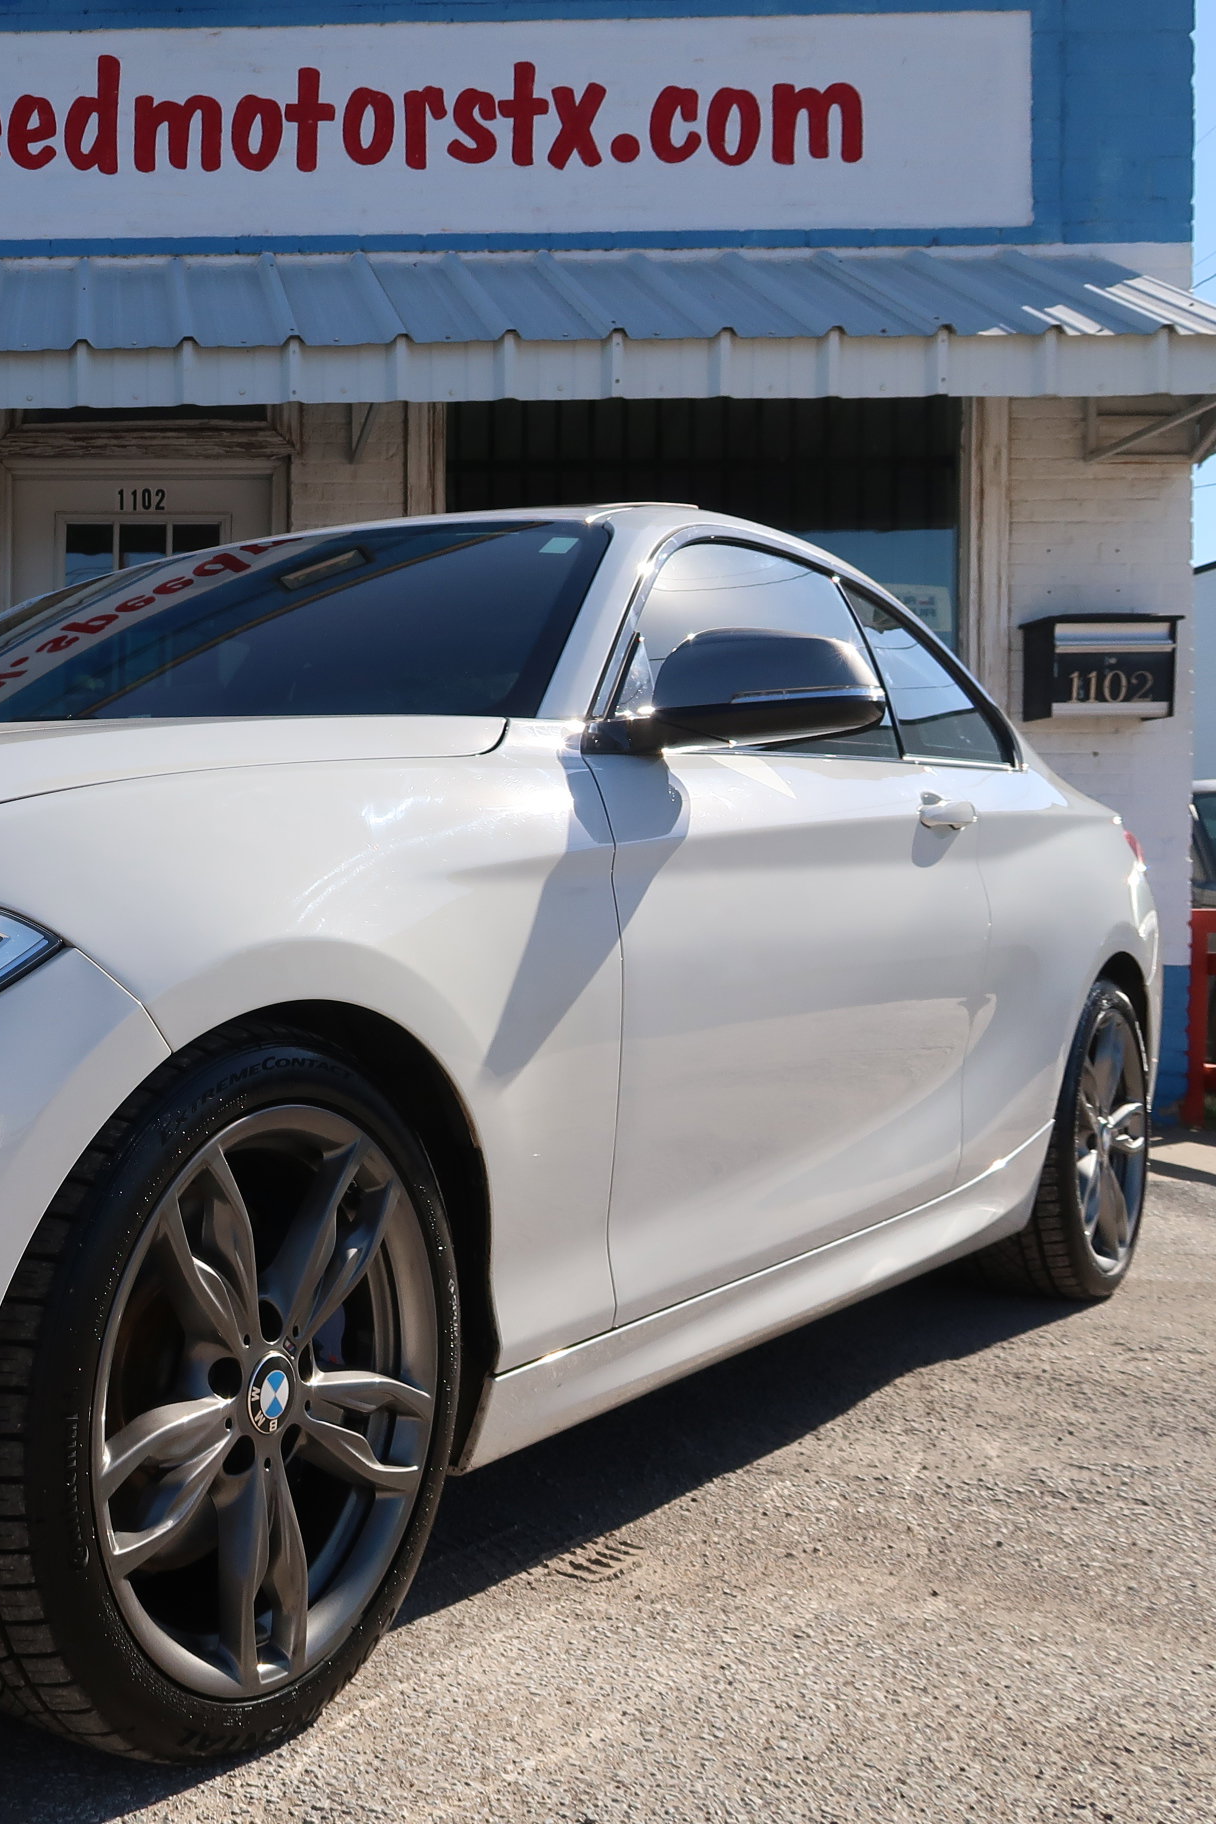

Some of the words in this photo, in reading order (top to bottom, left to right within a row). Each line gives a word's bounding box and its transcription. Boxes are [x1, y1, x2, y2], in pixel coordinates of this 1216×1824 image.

[117, 488, 166, 511] 1102
[1068, 670, 1154, 703] 1102
[249, 1386, 278, 1432] BMW
